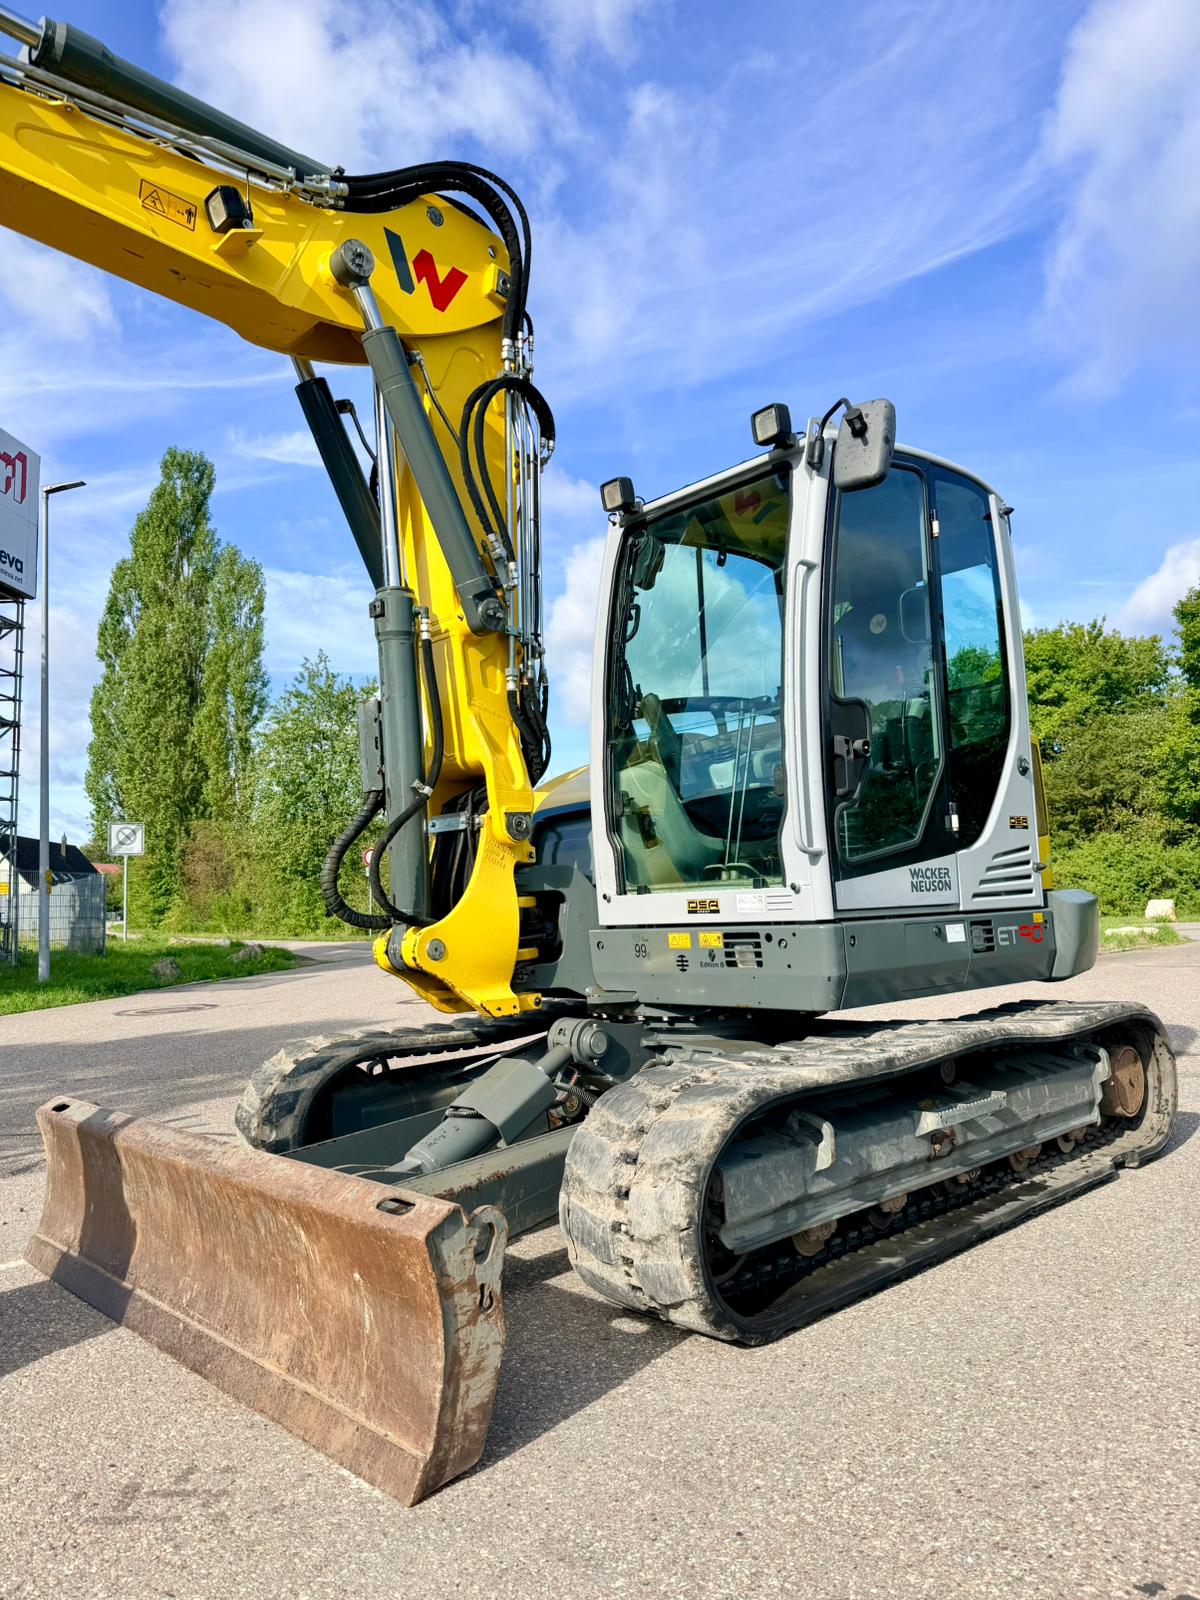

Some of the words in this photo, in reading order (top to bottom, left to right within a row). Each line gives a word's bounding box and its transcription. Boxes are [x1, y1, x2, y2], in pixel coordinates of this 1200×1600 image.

[909, 867, 951, 880] WACKER
[911, 880, 952, 893] NEUSON
[997, 924, 1043, 946] ET90
[634, 943, 648, 959] 99
